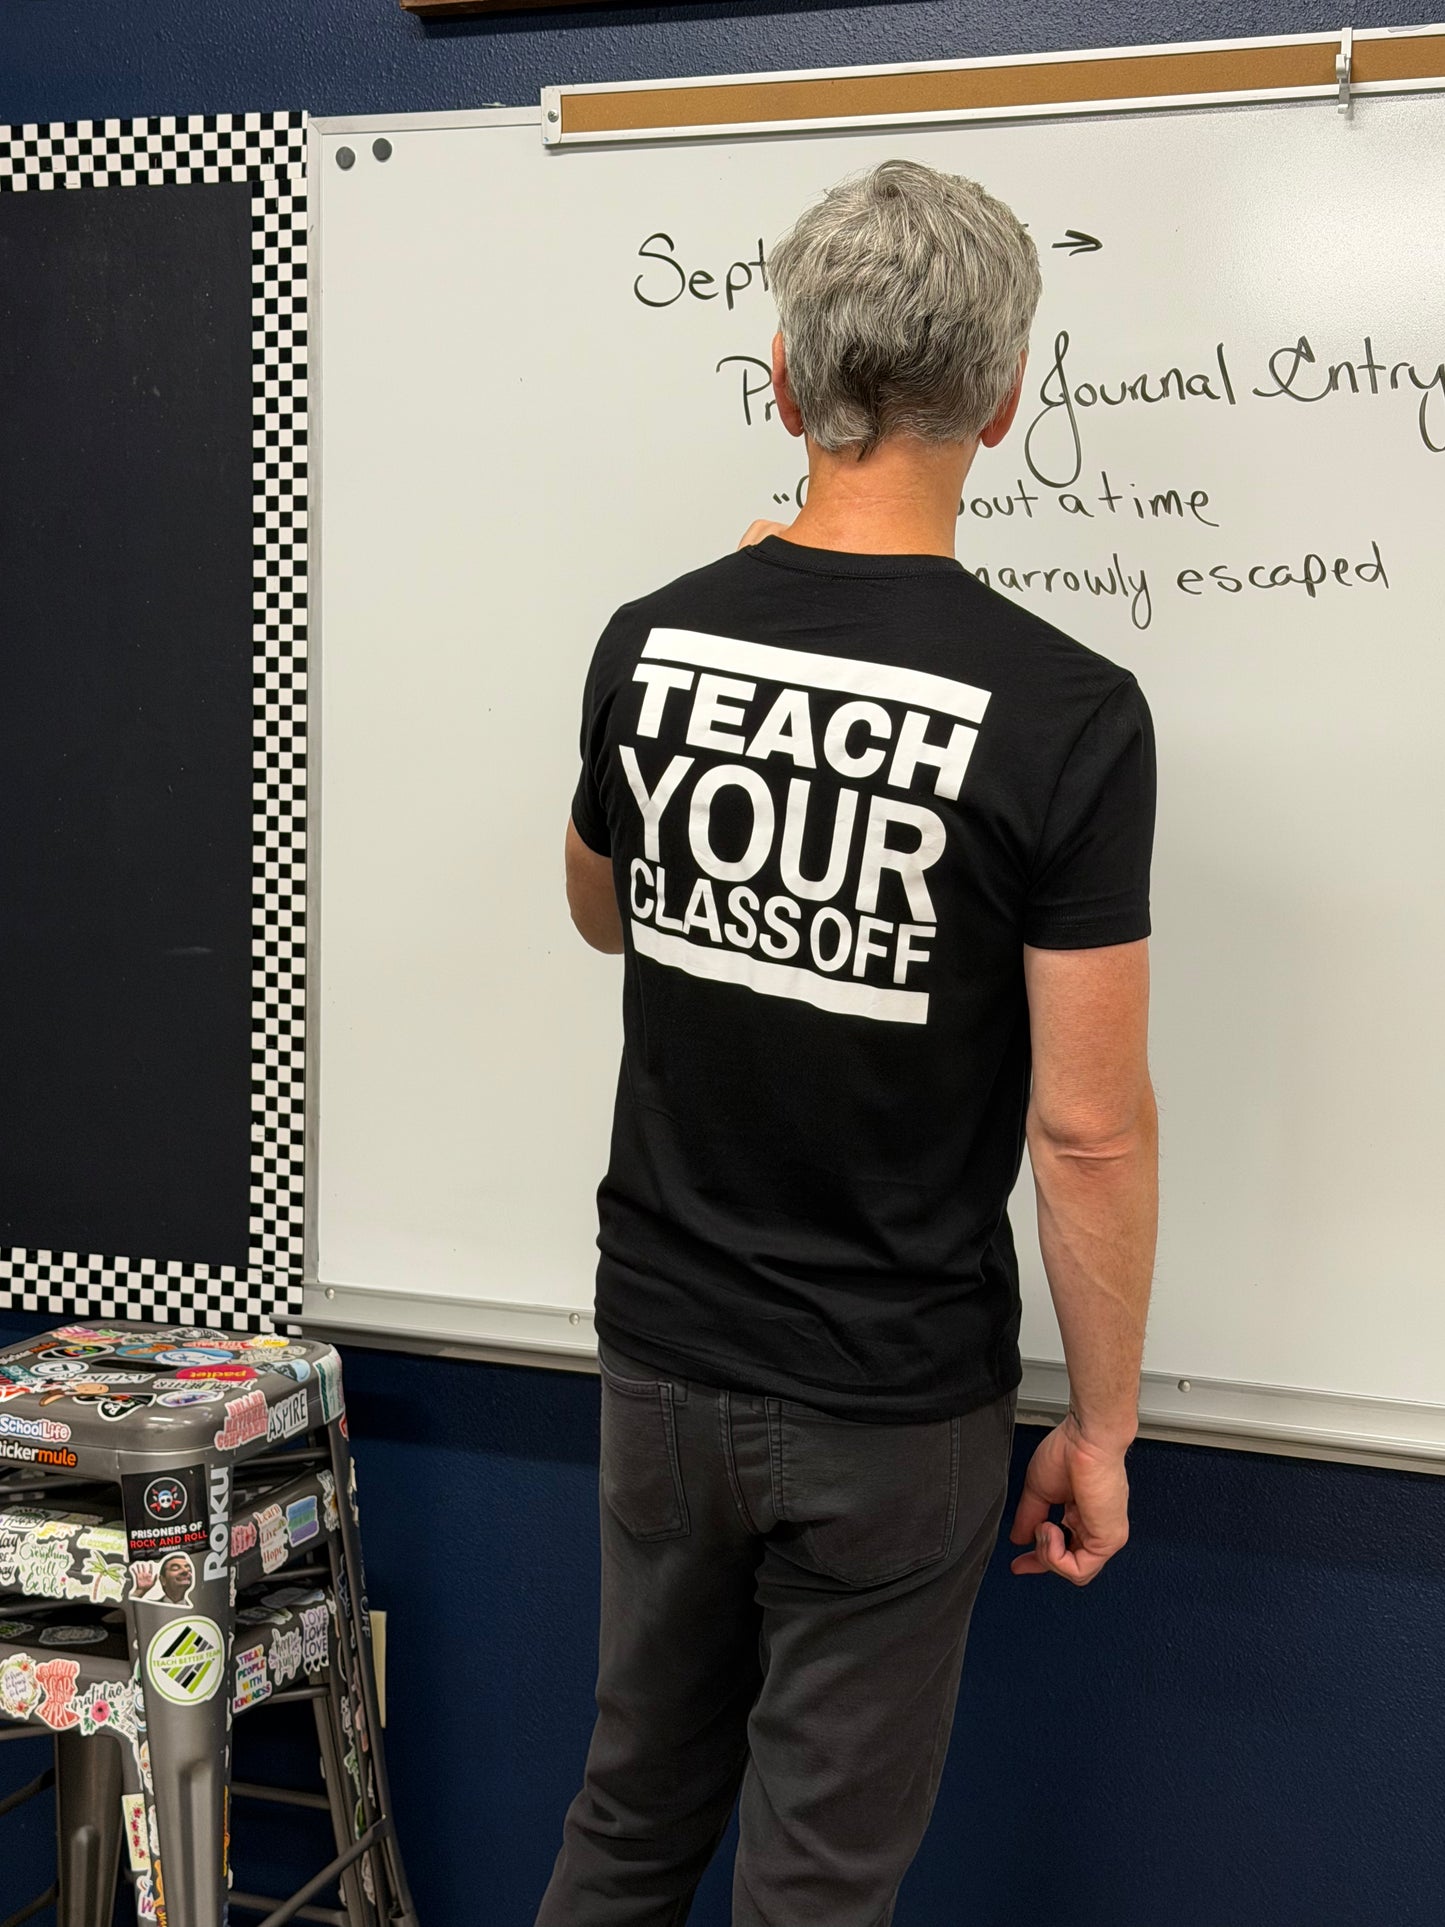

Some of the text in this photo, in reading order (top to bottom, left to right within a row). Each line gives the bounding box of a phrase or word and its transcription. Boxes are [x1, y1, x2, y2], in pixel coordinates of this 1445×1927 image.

[1024, 330, 1237, 489] Journal
[1252, 335, 1445, 452] Entry
[957, 479, 1038, 519] out
[1098, 471, 1220, 527] time
[973, 540, 1390, 630] narrowly escaped
[632, 663, 979, 801] TEACH
[619, 745, 947, 923] YOUR
[630, 857, 937, 985] CLASS OFF
[0, 1416, 68, 1439] SchoolLife
[268, 1393, 306, 1439] ASPIRE
[131, 1524, 188, 1540] PRISONERS
[189, 1521, 203, 1532] OF
[203, 1466, 229, 1581] ROKU
[130, 1538, 156, 1549] ROCK
[160, 1535, 182, 1547] AND
[184, 1530, 208, 1543] ROLL
[302, 1607, 327, 1628] LOVE
[304, 1624, 327, 1644] LOVE
[153, 1659, 177, 1668] TEACH
[179, 1655, 204, 1665] BETTER
[304, 1639, 327, 1659] LOVE
[237, 1659, 265, 1680] PEOPLE
[234, 1683, 271, 1709] KINDNESS
